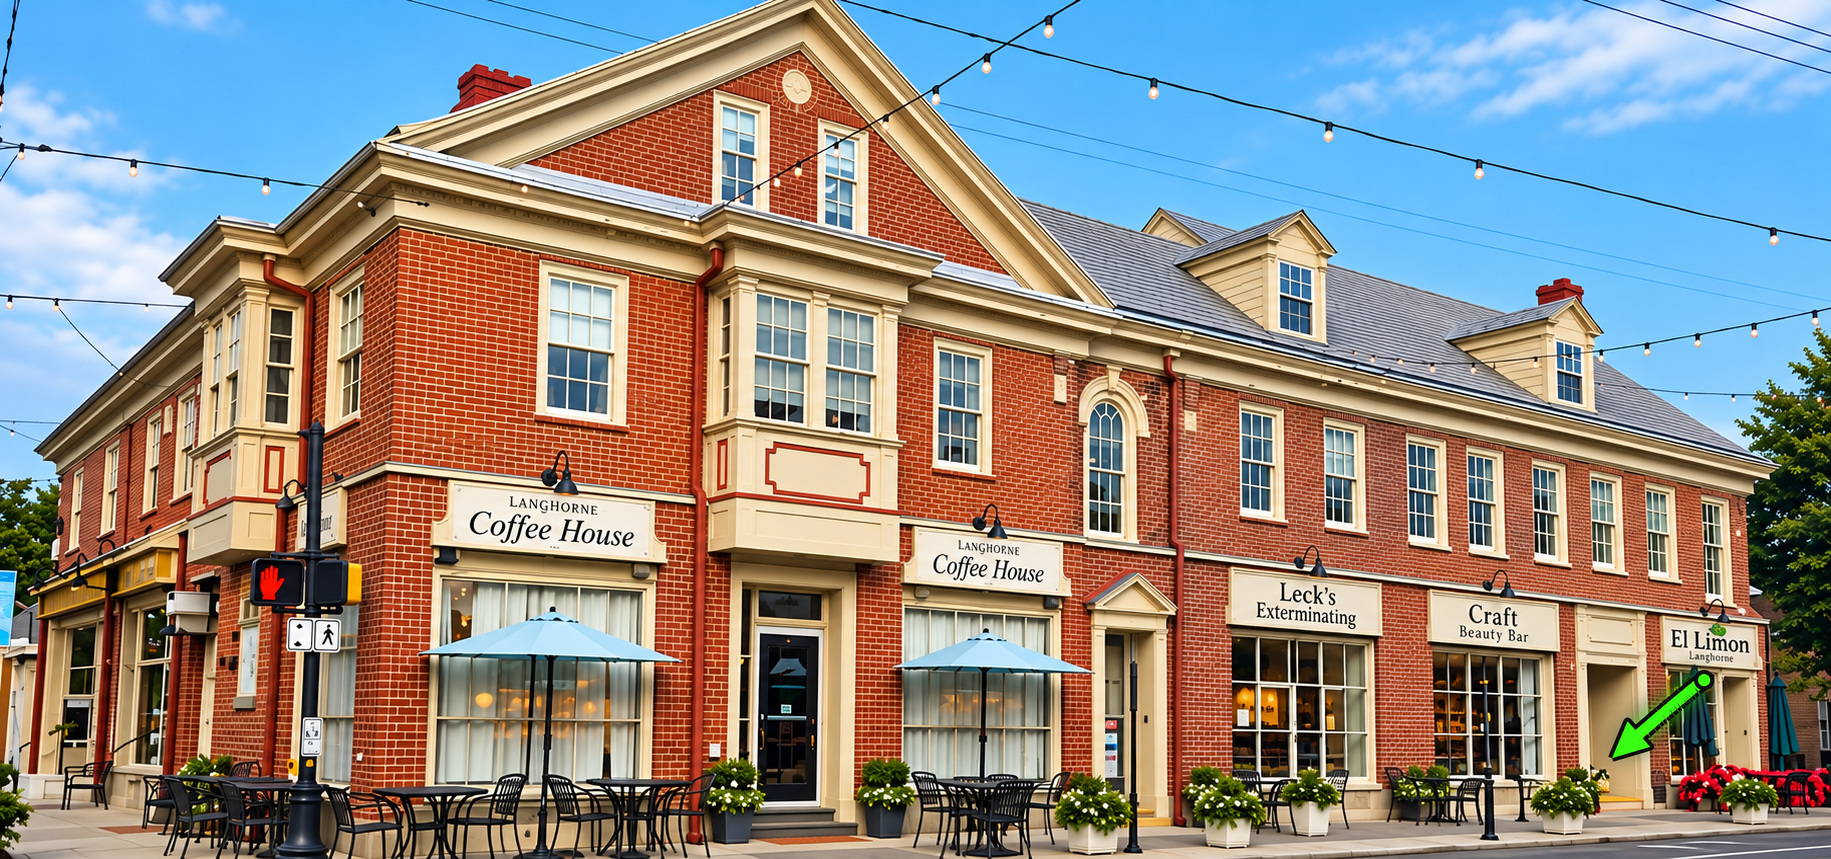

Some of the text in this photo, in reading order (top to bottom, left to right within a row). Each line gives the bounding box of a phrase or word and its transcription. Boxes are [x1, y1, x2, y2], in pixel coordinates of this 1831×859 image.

[509, 496, 599, 515] LANGHORNE
[469, 510, 635, 547] Coffee House
[957, 540, 1020, 555] LANGHORNE
[933, 553, 1045, 582] Coffee House
[1279, 582, 1336, 606] Leck's
[1256, 602, 1357, 629] Exterminating
[1468, 604, 1518, 627] Craft
[1459, 625, 1529, 643] Beauty Bar
[1671, 629, 1750, 653] El Limon
[1689, 650, 1734, 664] Langhorne
